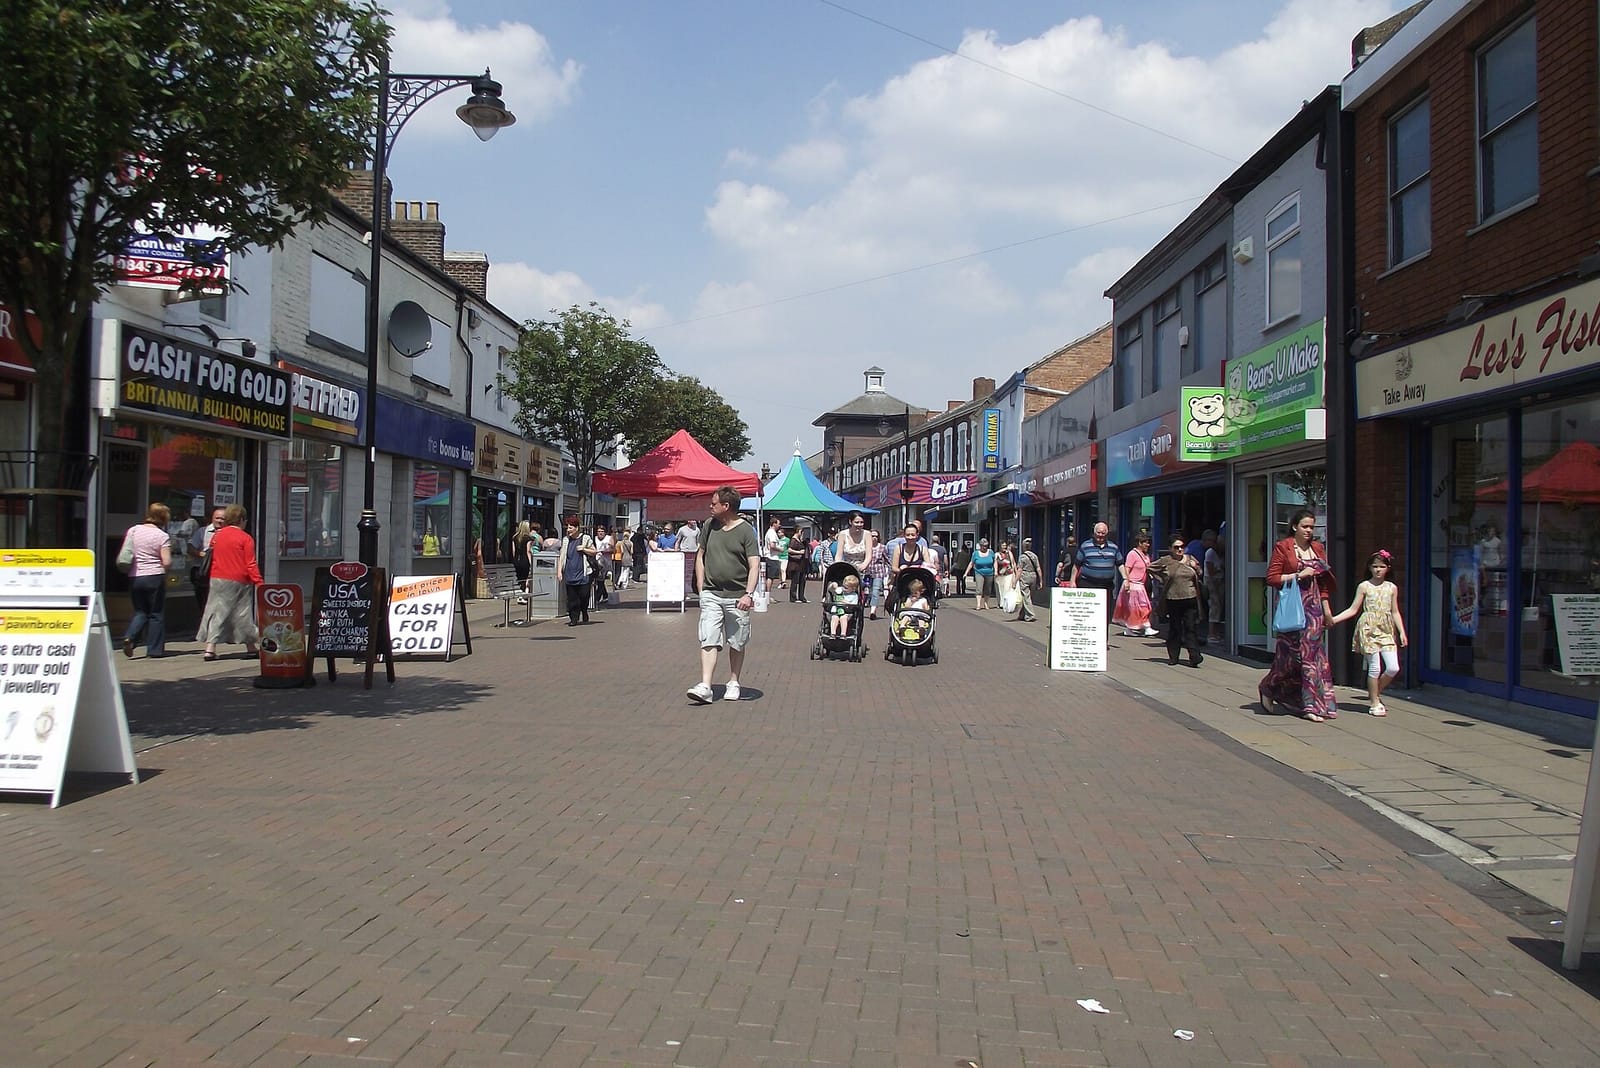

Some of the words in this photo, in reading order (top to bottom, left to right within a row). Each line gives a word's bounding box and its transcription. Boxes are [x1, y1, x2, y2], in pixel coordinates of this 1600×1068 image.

[1460, 316, 1527, 382] Les's
[128, 336, 190, 383] CASH
[197, 355, 236, 394] FOR
[241, 368, 287, 406] GOLD
[1247, 361, 1274, 392] Bears
[1276, 348, 1287, 382] U
[1288, 337, 1319, 379] Make
[292, 373, 360, 420] BETFRED
[1383, 387, 1401, 405] Take
[1403, 383, 1426, 402] Away
[126, 381, 199, 414] BRITANNIA
[203, 399, 251, 425] BULLION
[253, 409, 286, 431] HOUSE
[439, 438, 460, 460] bonus
[461, 444, 475, 464] king
[1151, 433, 1172, 456] save
[16, 556, 67, 564] pawnbroker
[328, 584, 359, 599] USA
[397, 584, 417, 594] Best
[322, 600, 346, 608] SWEETS
[346, 600, 371, 609] INSIDE!
[394, 602, 447, 615] CASH
[319, 609, 349, 618] WONKA
[5, 620, 74, 631] pawnbroker
[318, 619, 335, 627] BABY
[336, 619, 354, 627] RUTH
[399, 620, 438, 632] FOR
[318, 628, 340, 636] LUCKY
[340, 627, 369, 636] CHARMS
[347, 636, 369, 645] SODAS
[391, 637, 444, 650] GOLD
[12, 643, 43, 656] extra
[47, 643, 76, 657] cash
[12, 662, 40, 676] your
[43, 661, 70, 676] gold
[3, 680, 61, 695] jewellery
